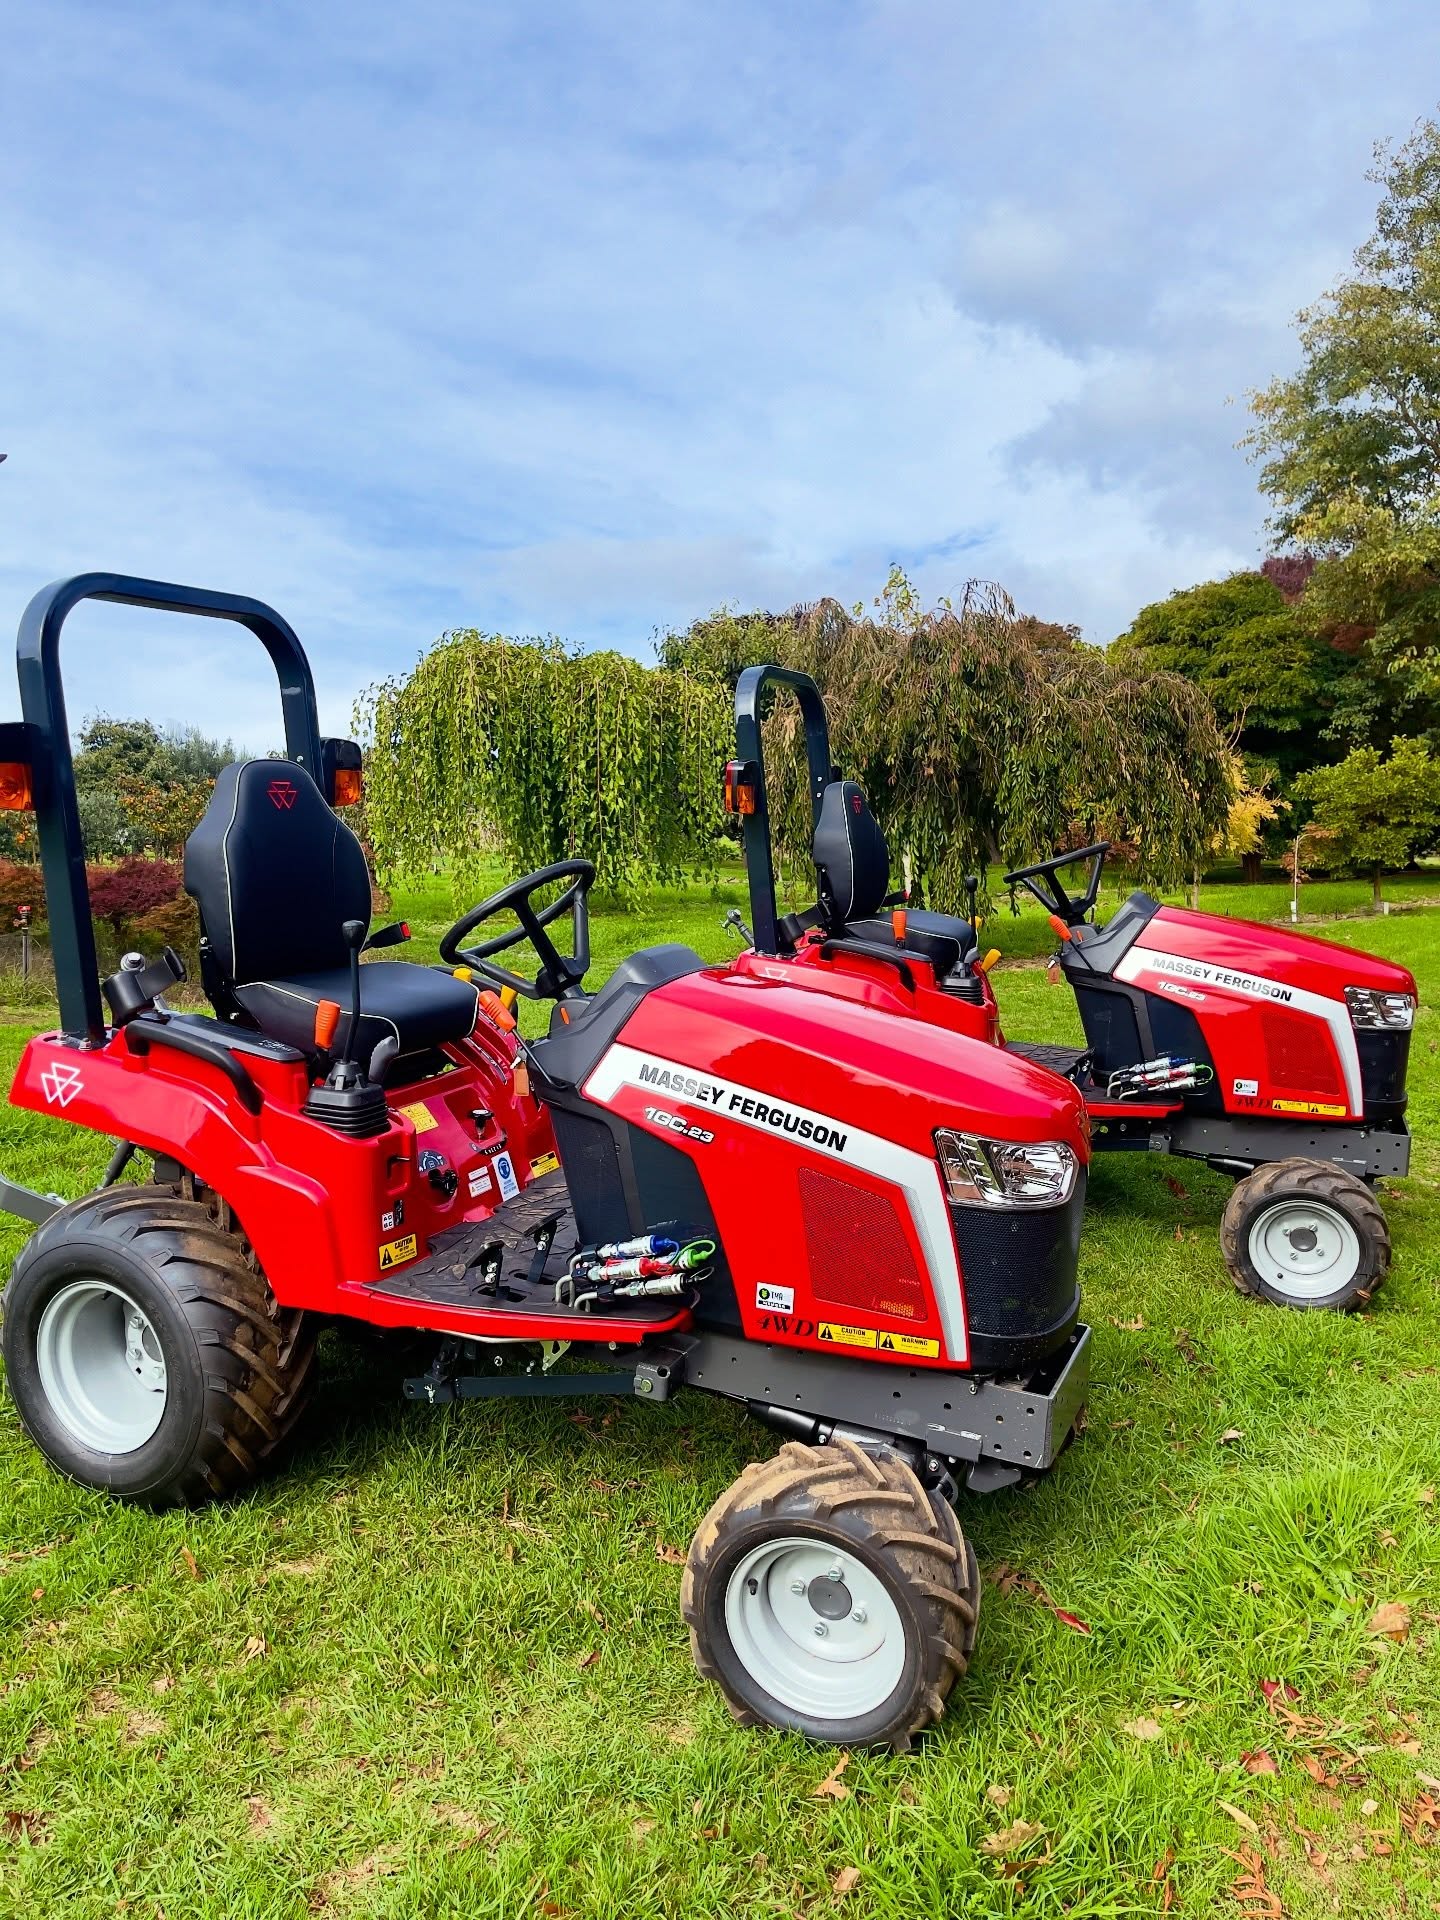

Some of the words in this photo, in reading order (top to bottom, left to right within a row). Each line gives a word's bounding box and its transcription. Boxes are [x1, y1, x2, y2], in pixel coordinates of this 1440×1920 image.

[1152, 957, 1211, 979] MASSEY
[1214, 972, 1292, 1002] FERGUSON
[638, 1063, 725, 1105] MASSEY
[728, 1093, 848, 1152] FERGUSON
[644, 1106, 715, 1144] 1GC.23
[756, 1314, 814, 1337] 4WD
[840, 1326, 866, 1337] CAUTION
[901, 1336, 928, 1347] WARNING
